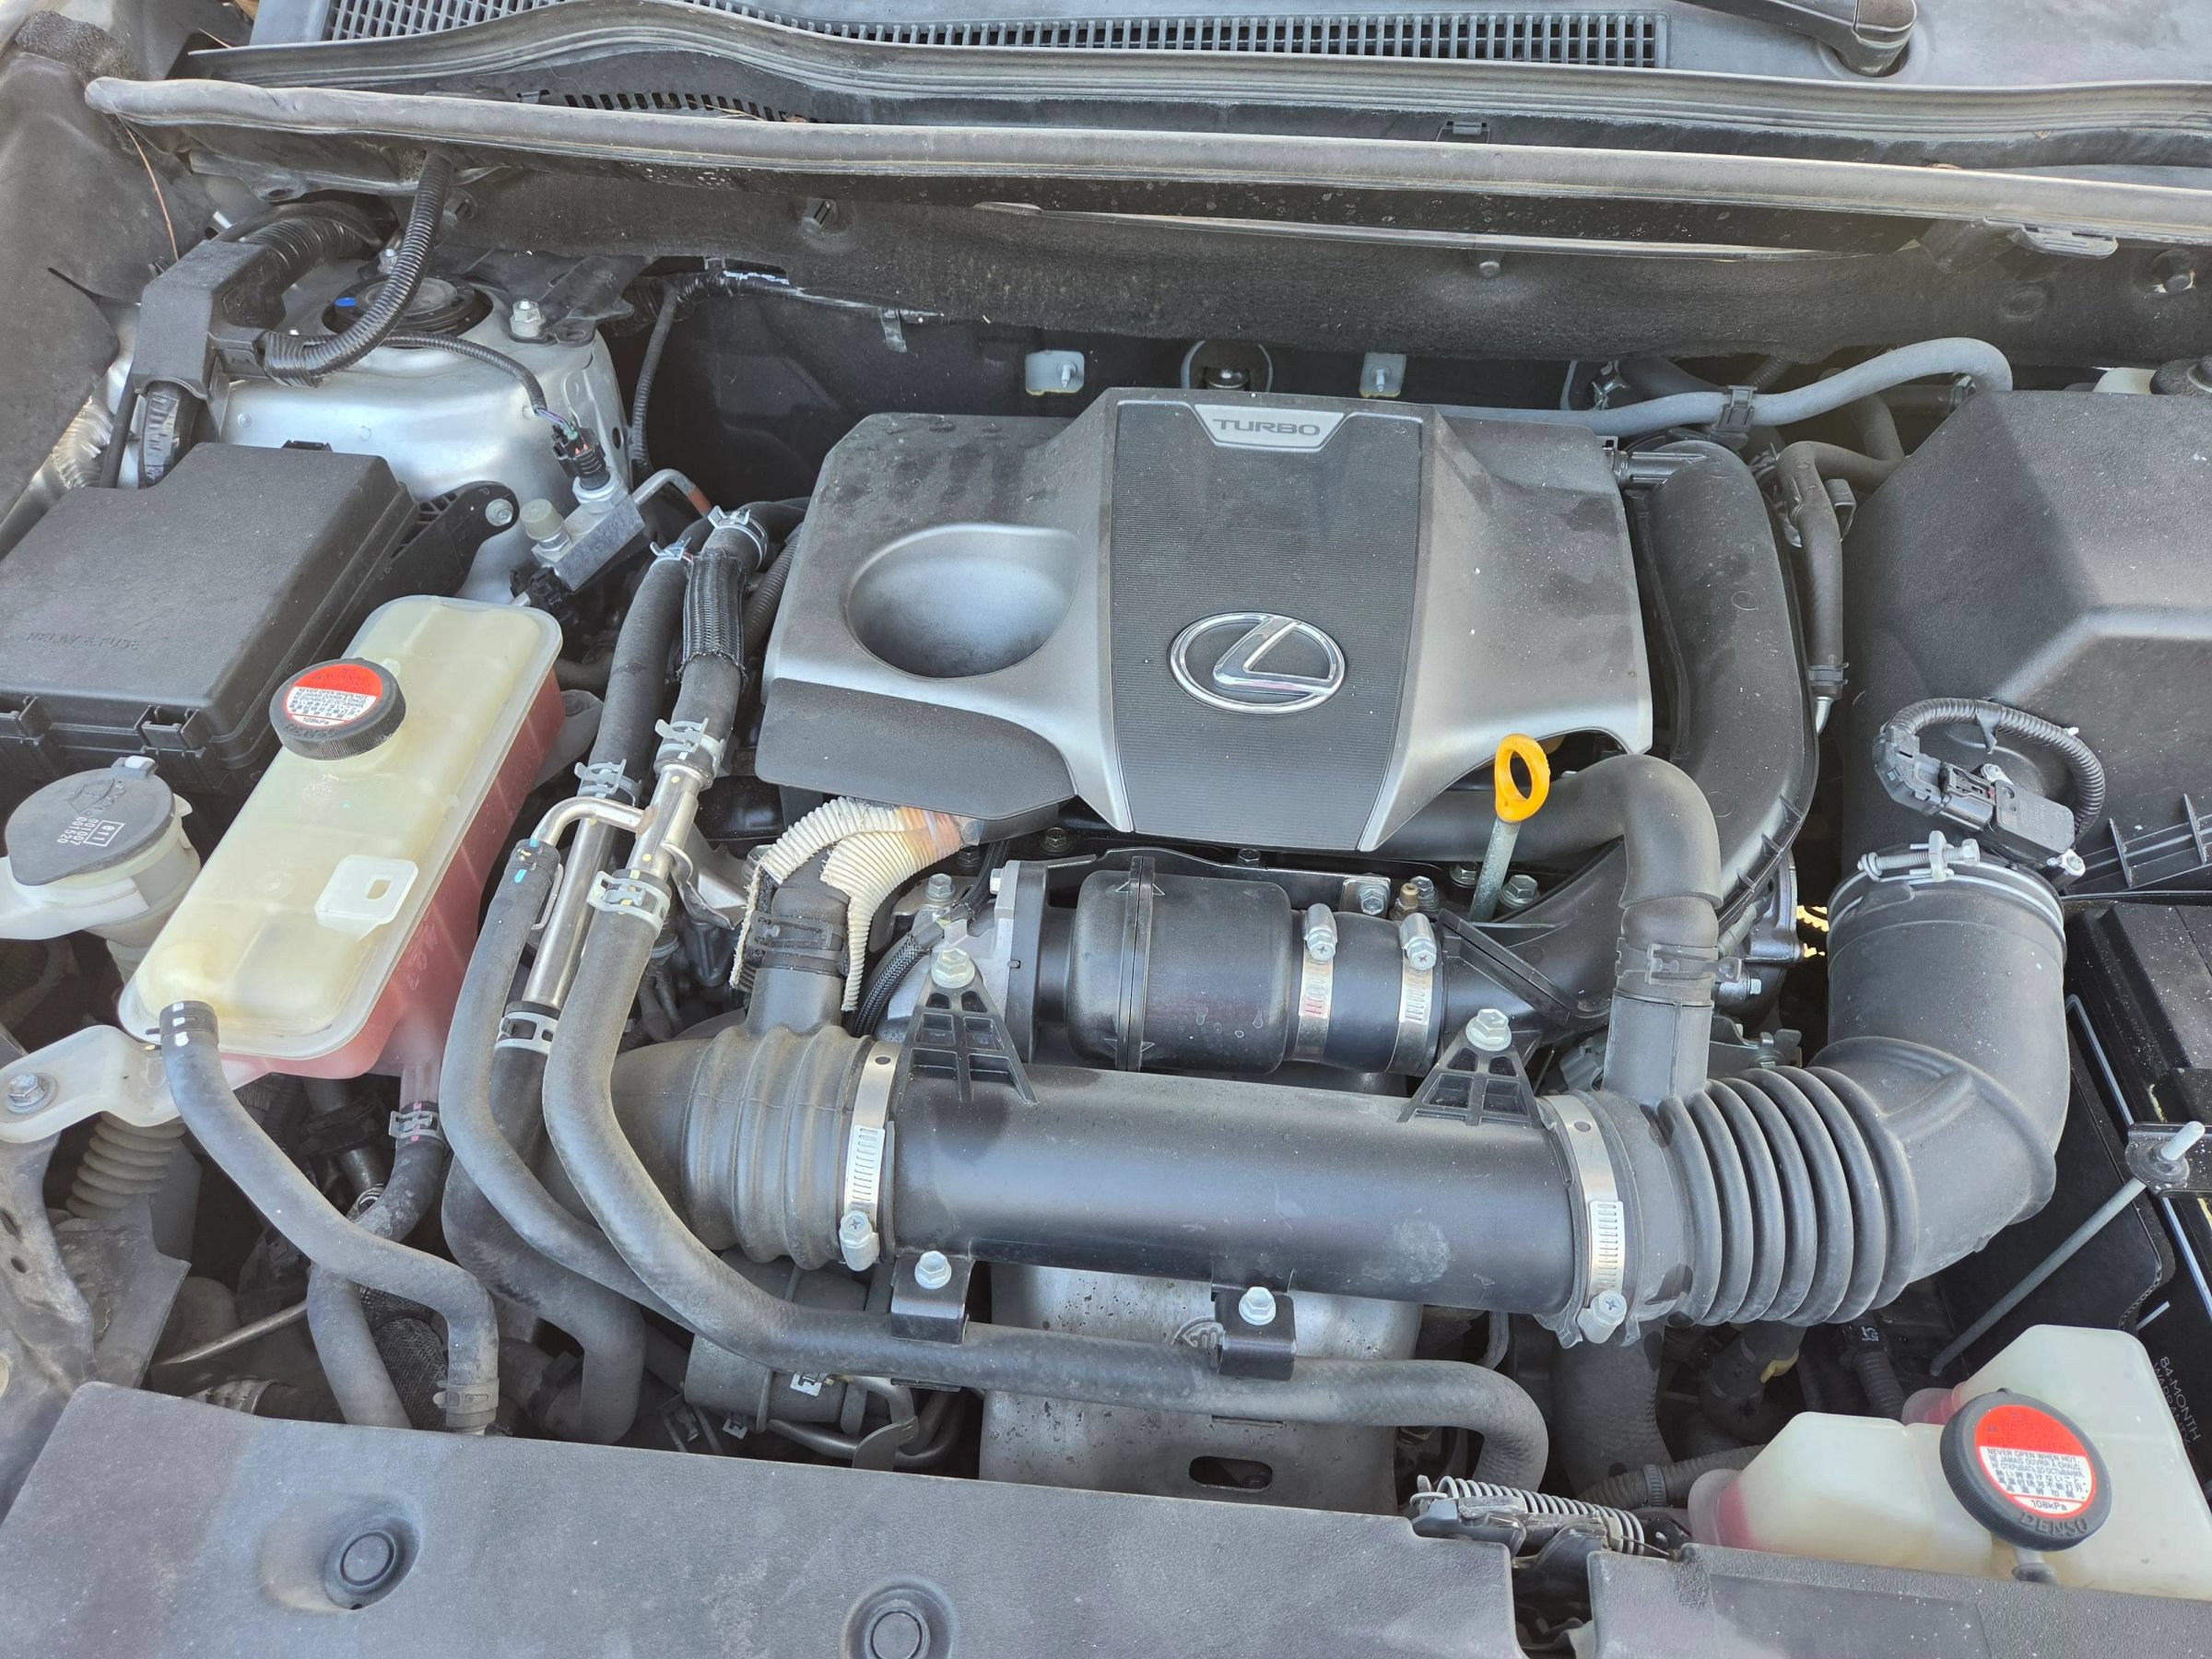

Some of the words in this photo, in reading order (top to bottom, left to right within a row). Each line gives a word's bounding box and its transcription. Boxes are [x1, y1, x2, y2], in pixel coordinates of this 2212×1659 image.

[1212, 418, 1321, 437] TURBO
[56, 817, 88, 844] 001520
[69, 818, 100, 845] 001007
[2159, 1356, 2202, 1441] 84-MONTH
[1987, 1448, 2013, 1456] NEVER
[2015, 1450, 2036, 1459] OPEN
[2038, 1453, 2060, 1461] WHEN
[2030, 1499, 2067, 1512] 108kPa
[2019, 1511, 2088, 1536] DENSO
